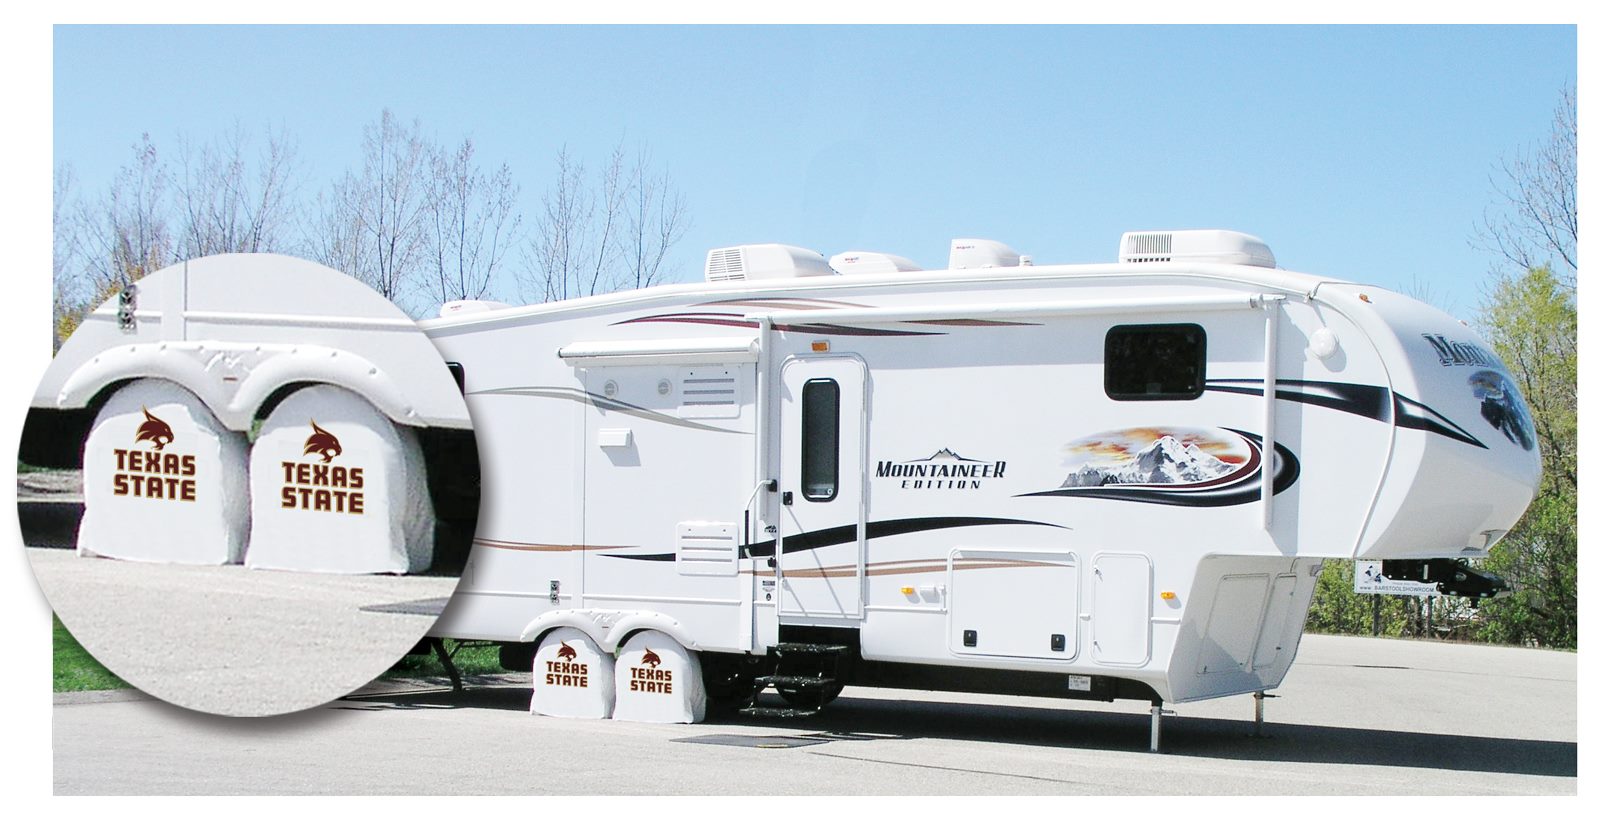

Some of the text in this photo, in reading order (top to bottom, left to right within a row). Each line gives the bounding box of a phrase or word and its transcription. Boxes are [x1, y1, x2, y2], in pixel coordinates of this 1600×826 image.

[114, 449, 195, 476] TEXAS
[877, 460, 1006, 478] MOUNTAINEER
[282, 461, 364, 489] TEXAS
[114, 474, 195, 502] STATE
[901, 480, 982, 489] EDITION
[282, 486, 364, 515] STATE
[546, 661, 588, 675] TEXAS
[631, 667, 673, 681] TEXAS
[546, 673, 588, 688] STATE
[631, 680, 673, 694] STATE
